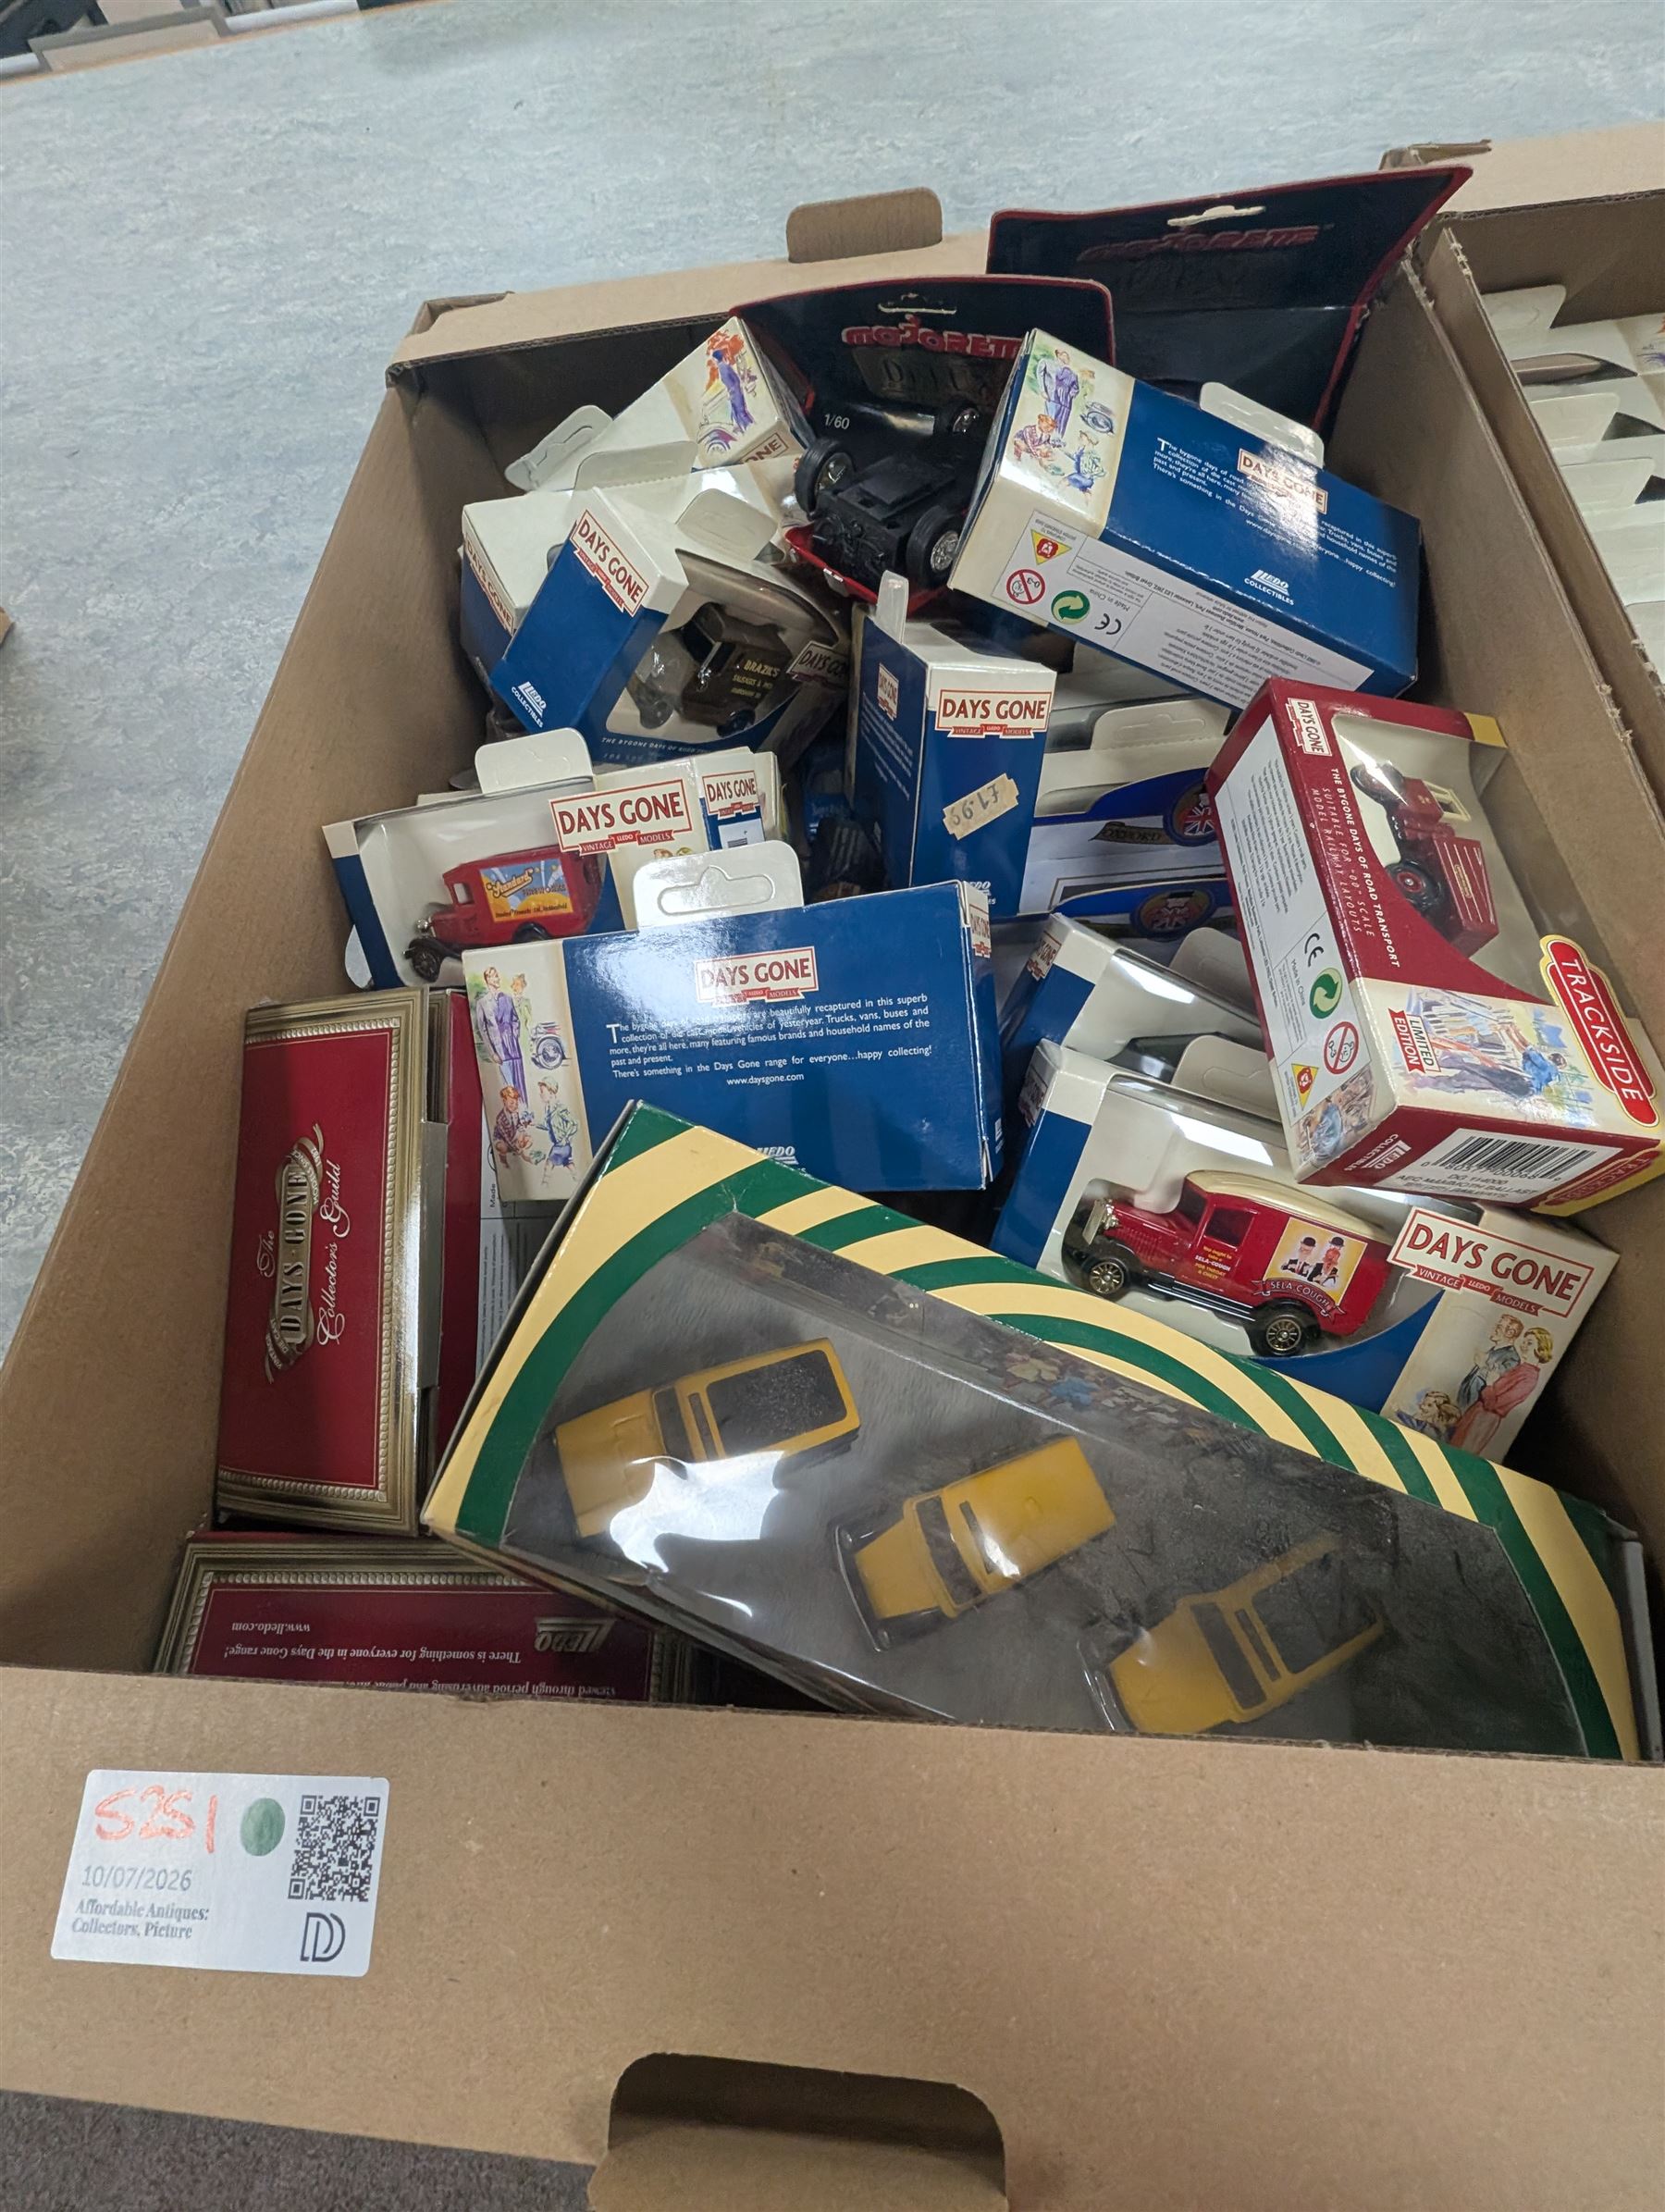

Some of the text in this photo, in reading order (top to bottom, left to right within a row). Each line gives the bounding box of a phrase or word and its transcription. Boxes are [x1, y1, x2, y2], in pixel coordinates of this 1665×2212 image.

[824, 414, 850, 430] 1/60
[577, 519, 643, 603] DAYS GONE
[466, 541, 512, 628] DAYS GONE
[1244, 578, 1294, 605] COLLECTIBLES
[800, 650, 828, 671] DAYS
[512, 686, 544, 727] COLLECTIBLES
[517, 681, 547, 717] LLEDO
[943, 698, 1046, 719] DAYS GONE
[1297, 701, 1325, 753] DAYS GONE
[707, 778, 757, 802] DAYS GONE
[1310, 788, 1328, 822] MODEL
[559, 803, 615, 834] DAYS
[620, 792, 684, 825] GONE
[582, 841, 614, 851] VINTAGE
[640, 833, 672, 843] MODELS
[1320, 787, 1375, 936] SUITABLE FOR SCALE
[1329, 768, 1400, 969] THE BYGONE DAYS OF ROAD TRANSPORT
[700, 958, 811, 988] DAYS GONE
[769, 988, 798, 997] MODELS
[769, 1004, 811, 1019] beautifully
[814, 999, 859, 1014] recaptured
[863, 998, 871, 1007] in
[877, 995, 893, 1007] this
[896, 993, 928, 1005] superb
[609, 1017, 930, 1057] more, they're all here, many featuring famous brands and household names of the
[622, 1030, 660, 1043] collection
[767, 1019, 775, 1029] of
[780, 1015, 823, 1030] yesteryear.
[824, 1012, 855, 1024] Trucks,
[858, 1010, 881, 1021] vans,
[883, 1007, 907, 1019] buses
[911, 1005, 928, 1017] and
[1393, 1017, 1420, 1065] EDITION
[1560, 958, 1643, 1104] TRACKSIDE
[1410, 1018, 1436, 1067] LIMITED
[610, 1053, 672, 1069] past and present.
[612, 1068, 639, 1081] There's
[642, 1064, 682, 1079] something
[685, 1064, 692, 1074] in
[696, 1063, 709, 1072] the
[713, 1060, 734, 1073] Days
[737, 1058, 760, 1069] Gone
[764, 1057, 787, 1069] range
[791, 1055, 803, 1065] for
[887, 1044, 932, 1058] collecting!
[726, 1069, 804, 1088] www.daysgone.com
[255, 1230, 275, 1278] The
[280, 1170, 307, 1332] DAYS GONE
[316, 1159, 350, 1345] Collector's Guild
[1195, 1254, 1231, 1271] SELA-COUGH
[1407, 1223, 1581, 1301] DAYS GONE
[1271, 1281, 1330, 1307] SELA COUGH
[1418, 1268, 1460, 1288] VINTAGE
[1495, 1293, 1537, 1313] MODELS
[230, 1620, 311, 1634] www.lledo.com
[532, 1616, 614, 1652] LLEDO
[223, 1643, 521, 1663] There is something for everyone in the Days Gone range!
[530, 1682, 575, 1696] through
[81, 1864, 192, 1892] 10/07/2026
[74, 1898, 210, 1921] Affordable Antiques:
[143, 1920, 192, 1939] Picture
